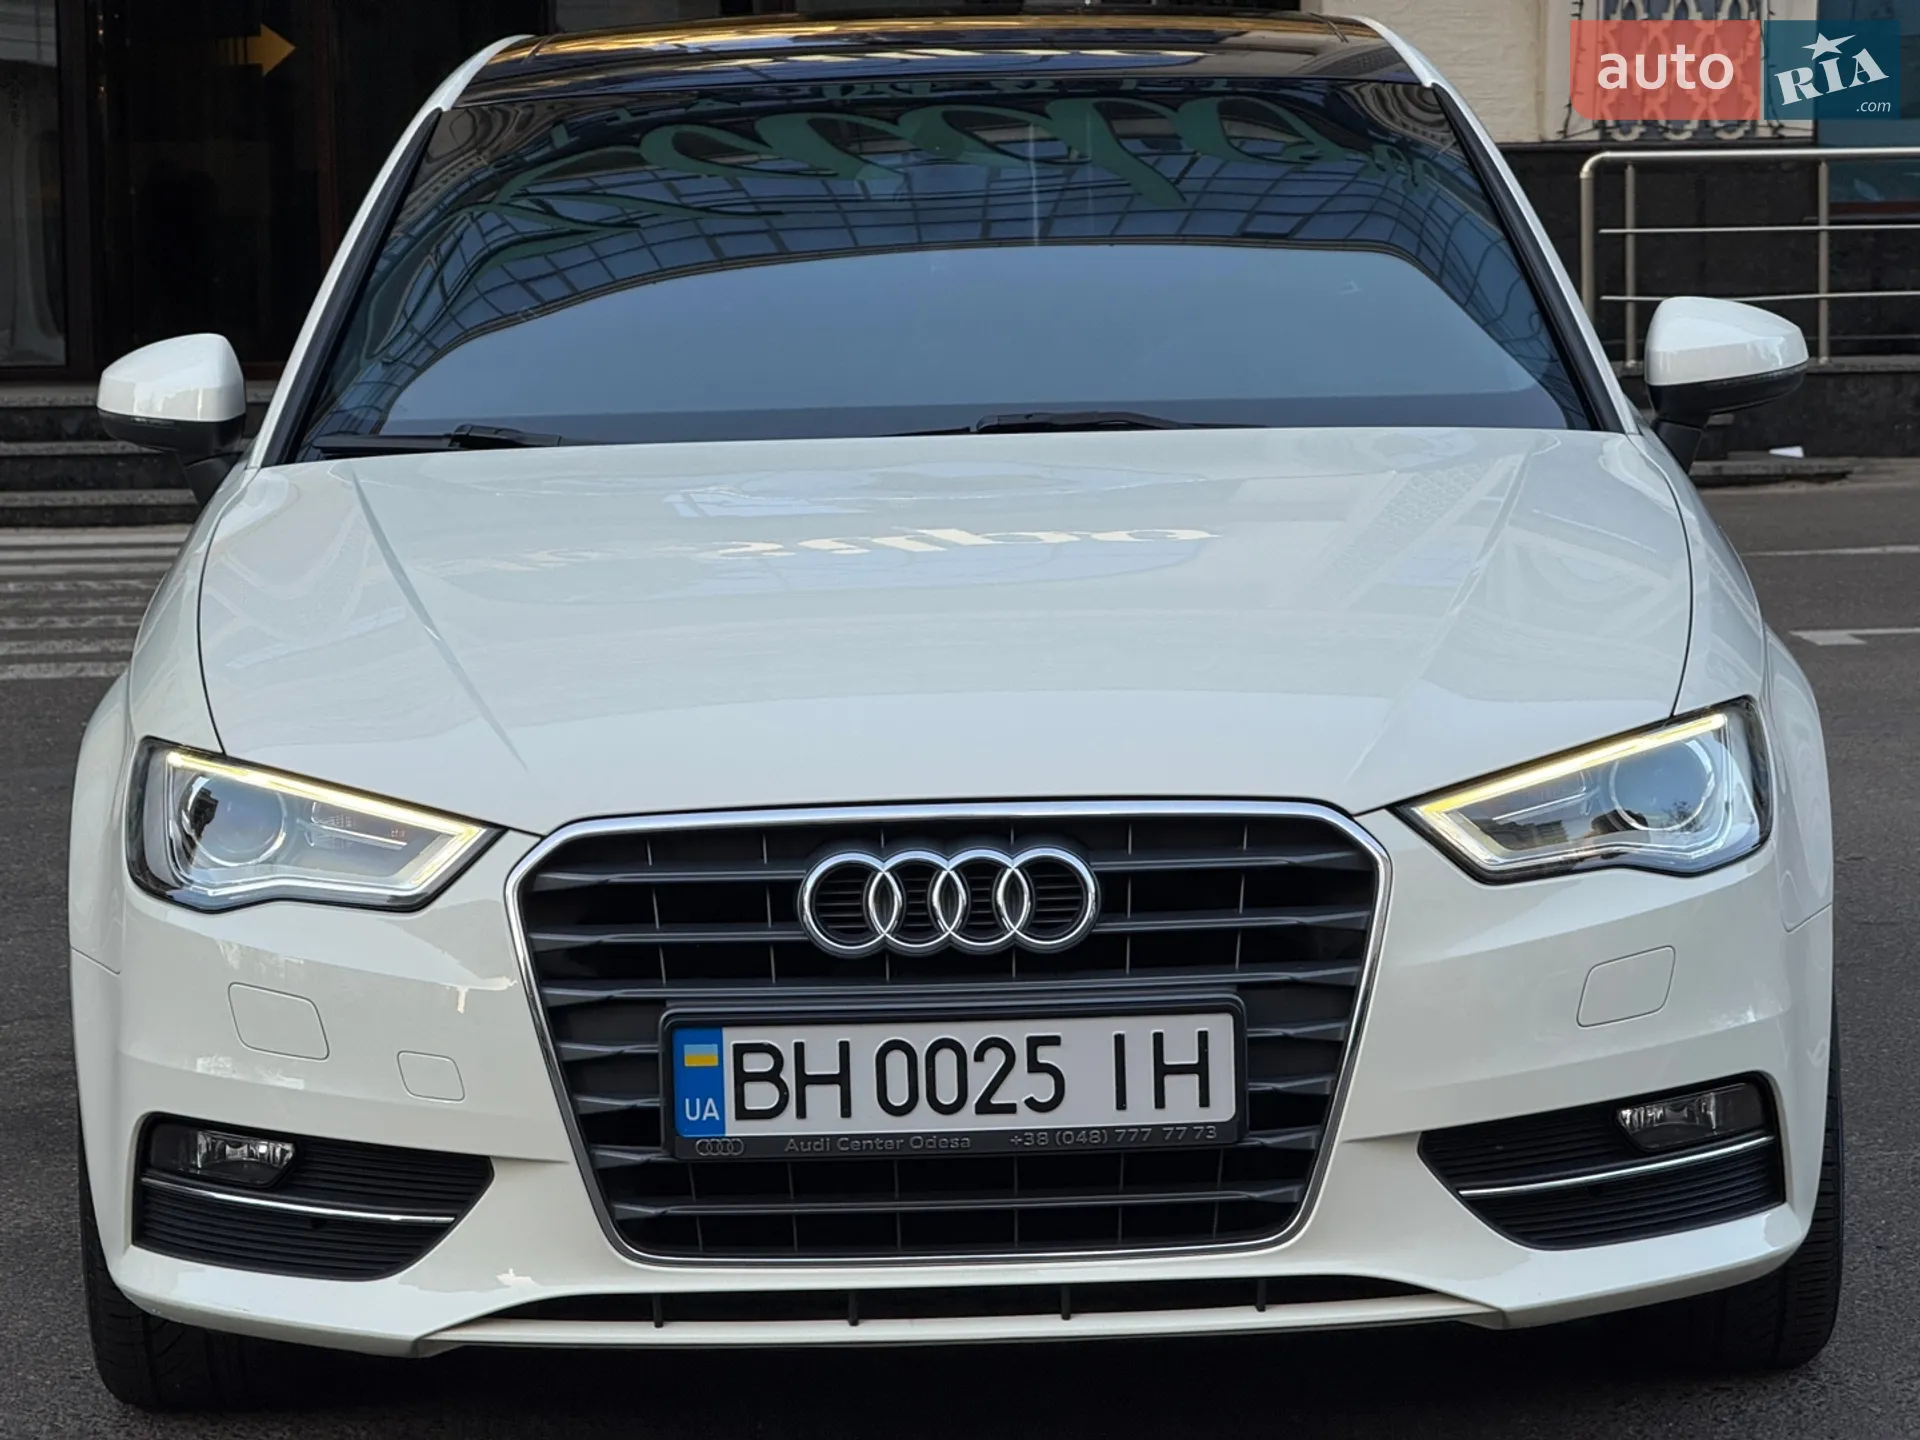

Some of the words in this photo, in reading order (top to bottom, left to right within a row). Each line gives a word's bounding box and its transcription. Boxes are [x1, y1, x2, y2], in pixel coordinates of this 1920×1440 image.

[732, 1039, 853, 1120] BH
[875, 1034, 1065, 1117] 0025
[1114, 1029, 1210, 1111] IH
[685, 1097, 720, 1121] UA
[784, 1137, 831, 1153] Audi
[836, 1135, 904, 1151] Center
[909, 1134, 972, 1150] Odesa
[1010, 1131, 1049, 1146] +38
[1055, 1129, 1108, 1146] (048)
[1115, 1128, 1152, 1142] 777
[1163, 1126, 1190, 1140] 77
[1193, 1125, 1218, 1140] 73
